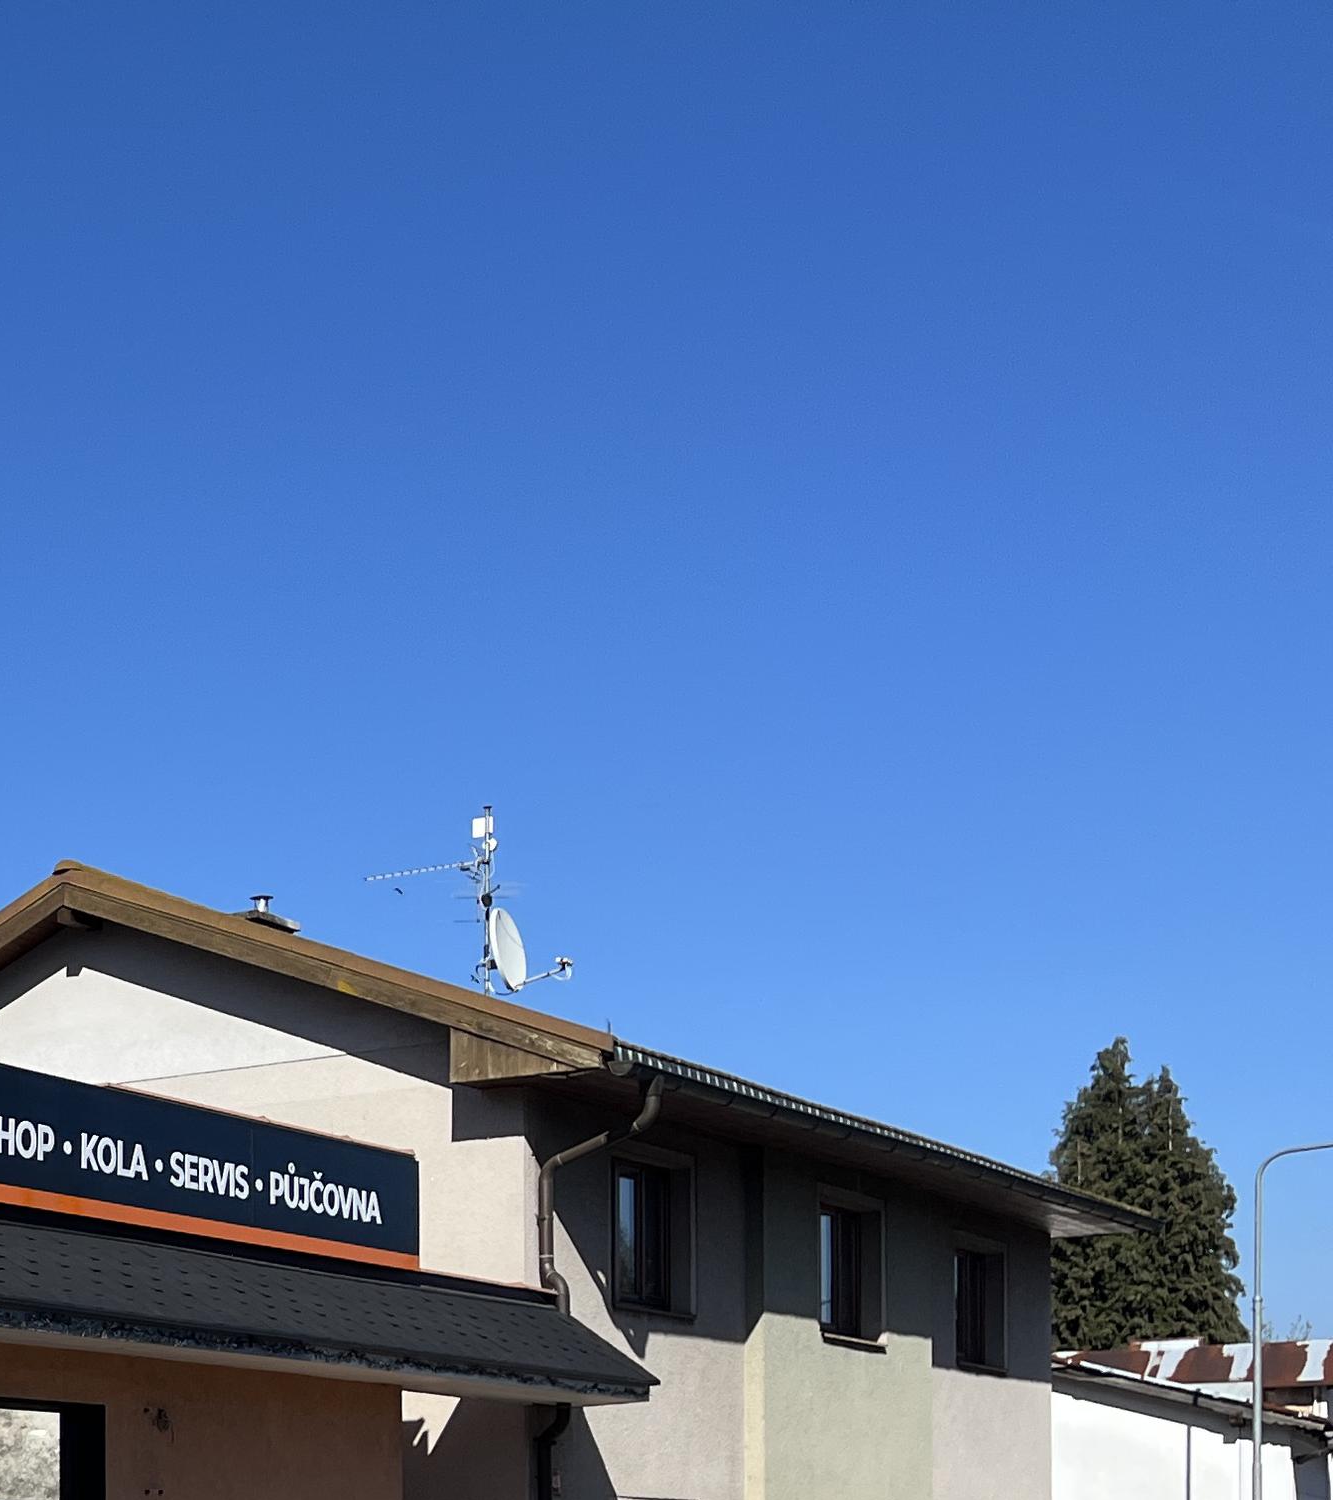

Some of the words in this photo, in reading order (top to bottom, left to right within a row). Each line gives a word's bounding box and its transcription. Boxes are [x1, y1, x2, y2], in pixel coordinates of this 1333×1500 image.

[80, 1132, 149, 1181] KOLA
[169, 1151, 250, 1200] SERVIS
[269, 1161, 383, 1225] PŮJČOVNA
